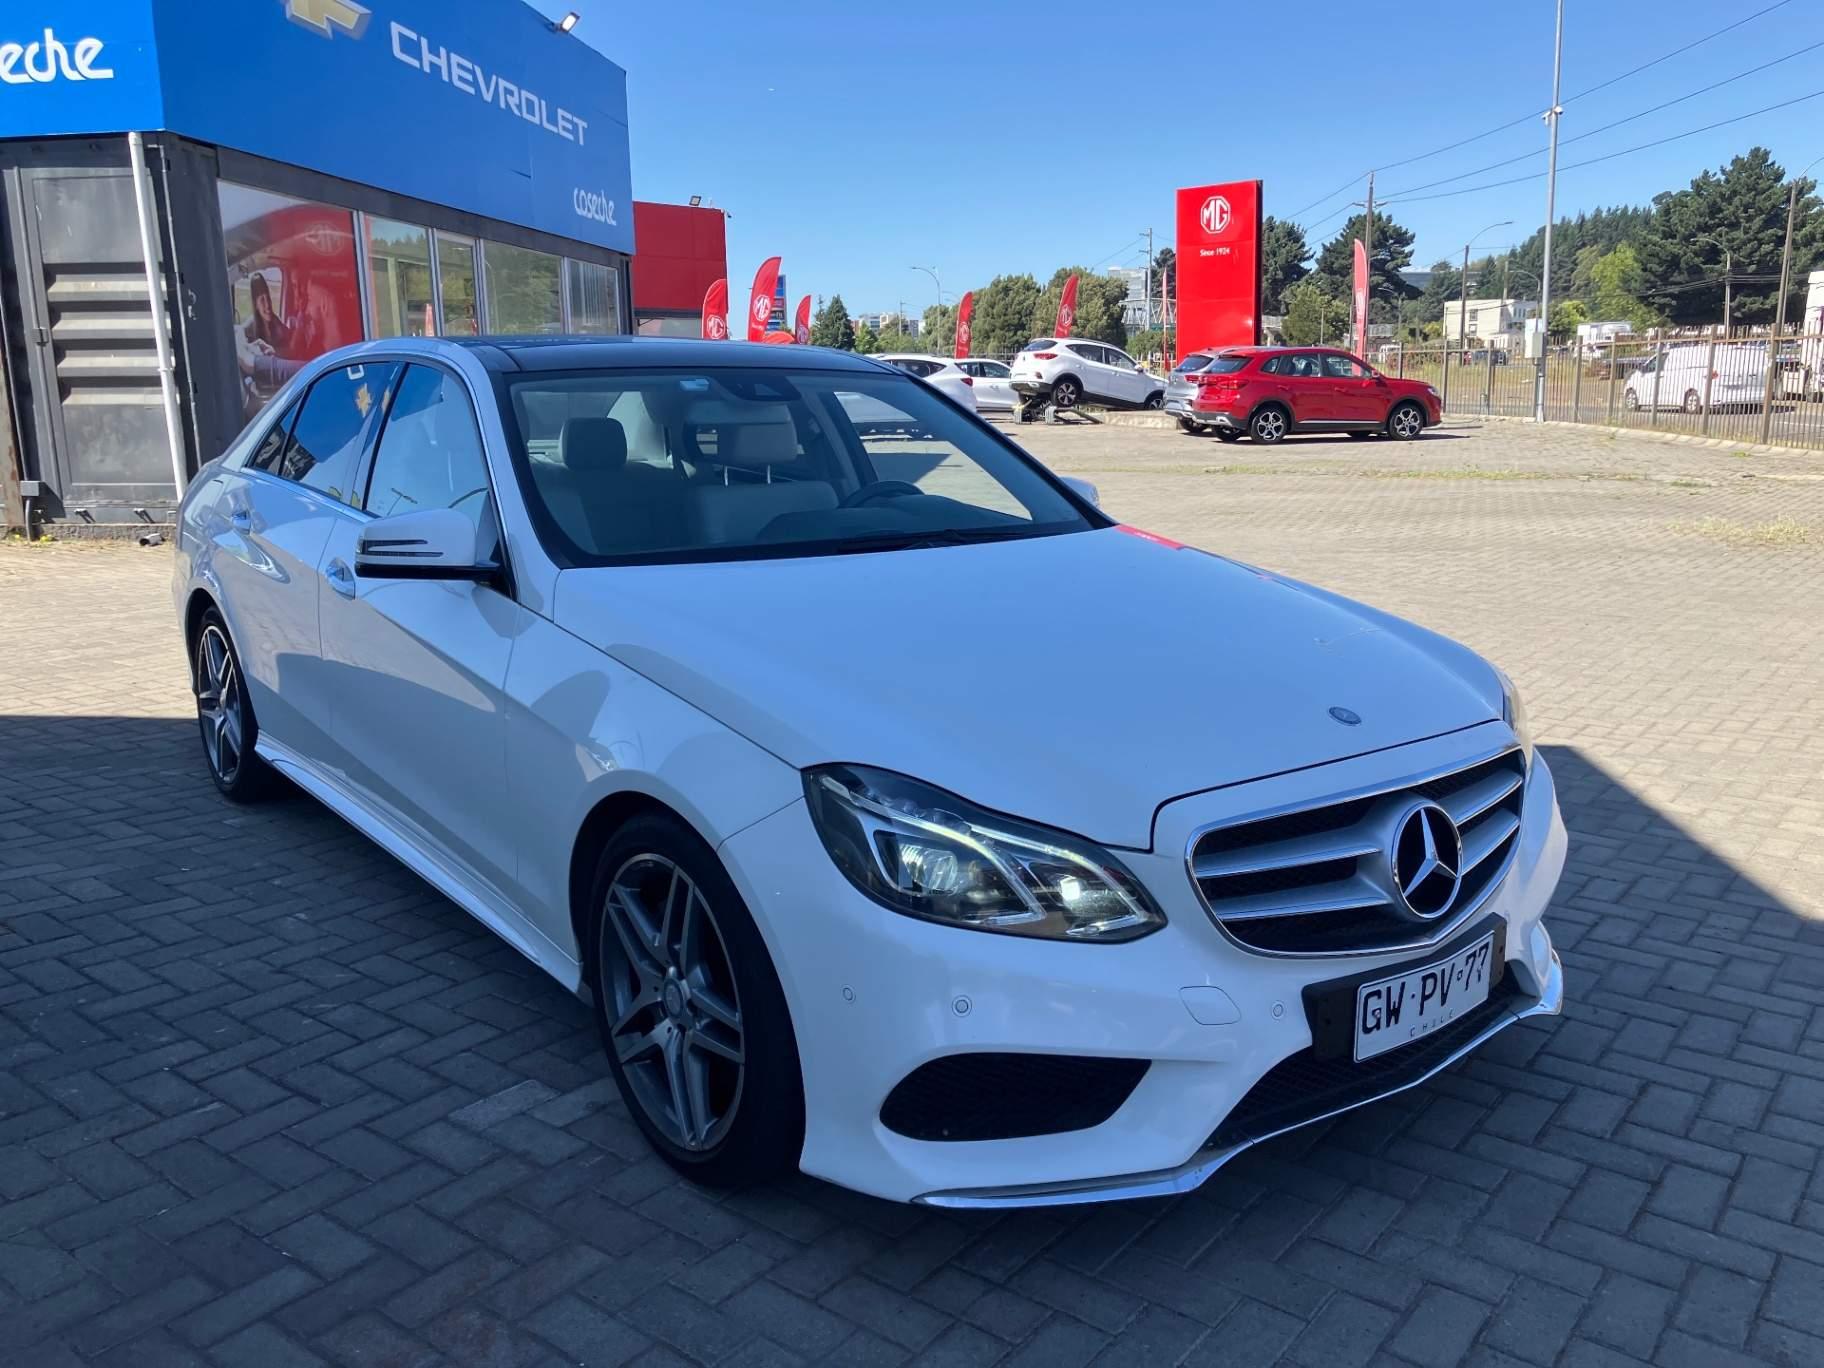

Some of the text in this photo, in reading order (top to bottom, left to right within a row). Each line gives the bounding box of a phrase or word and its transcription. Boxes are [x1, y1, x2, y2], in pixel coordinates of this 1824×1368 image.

[390, 20, 589, 147] CHEVROLET
[573, 187, 617, 226] coseche
[1201, 197, 1230, 232] MG
[754, 295, 770, 320] MG
[708, 316, 724, 338] MG
